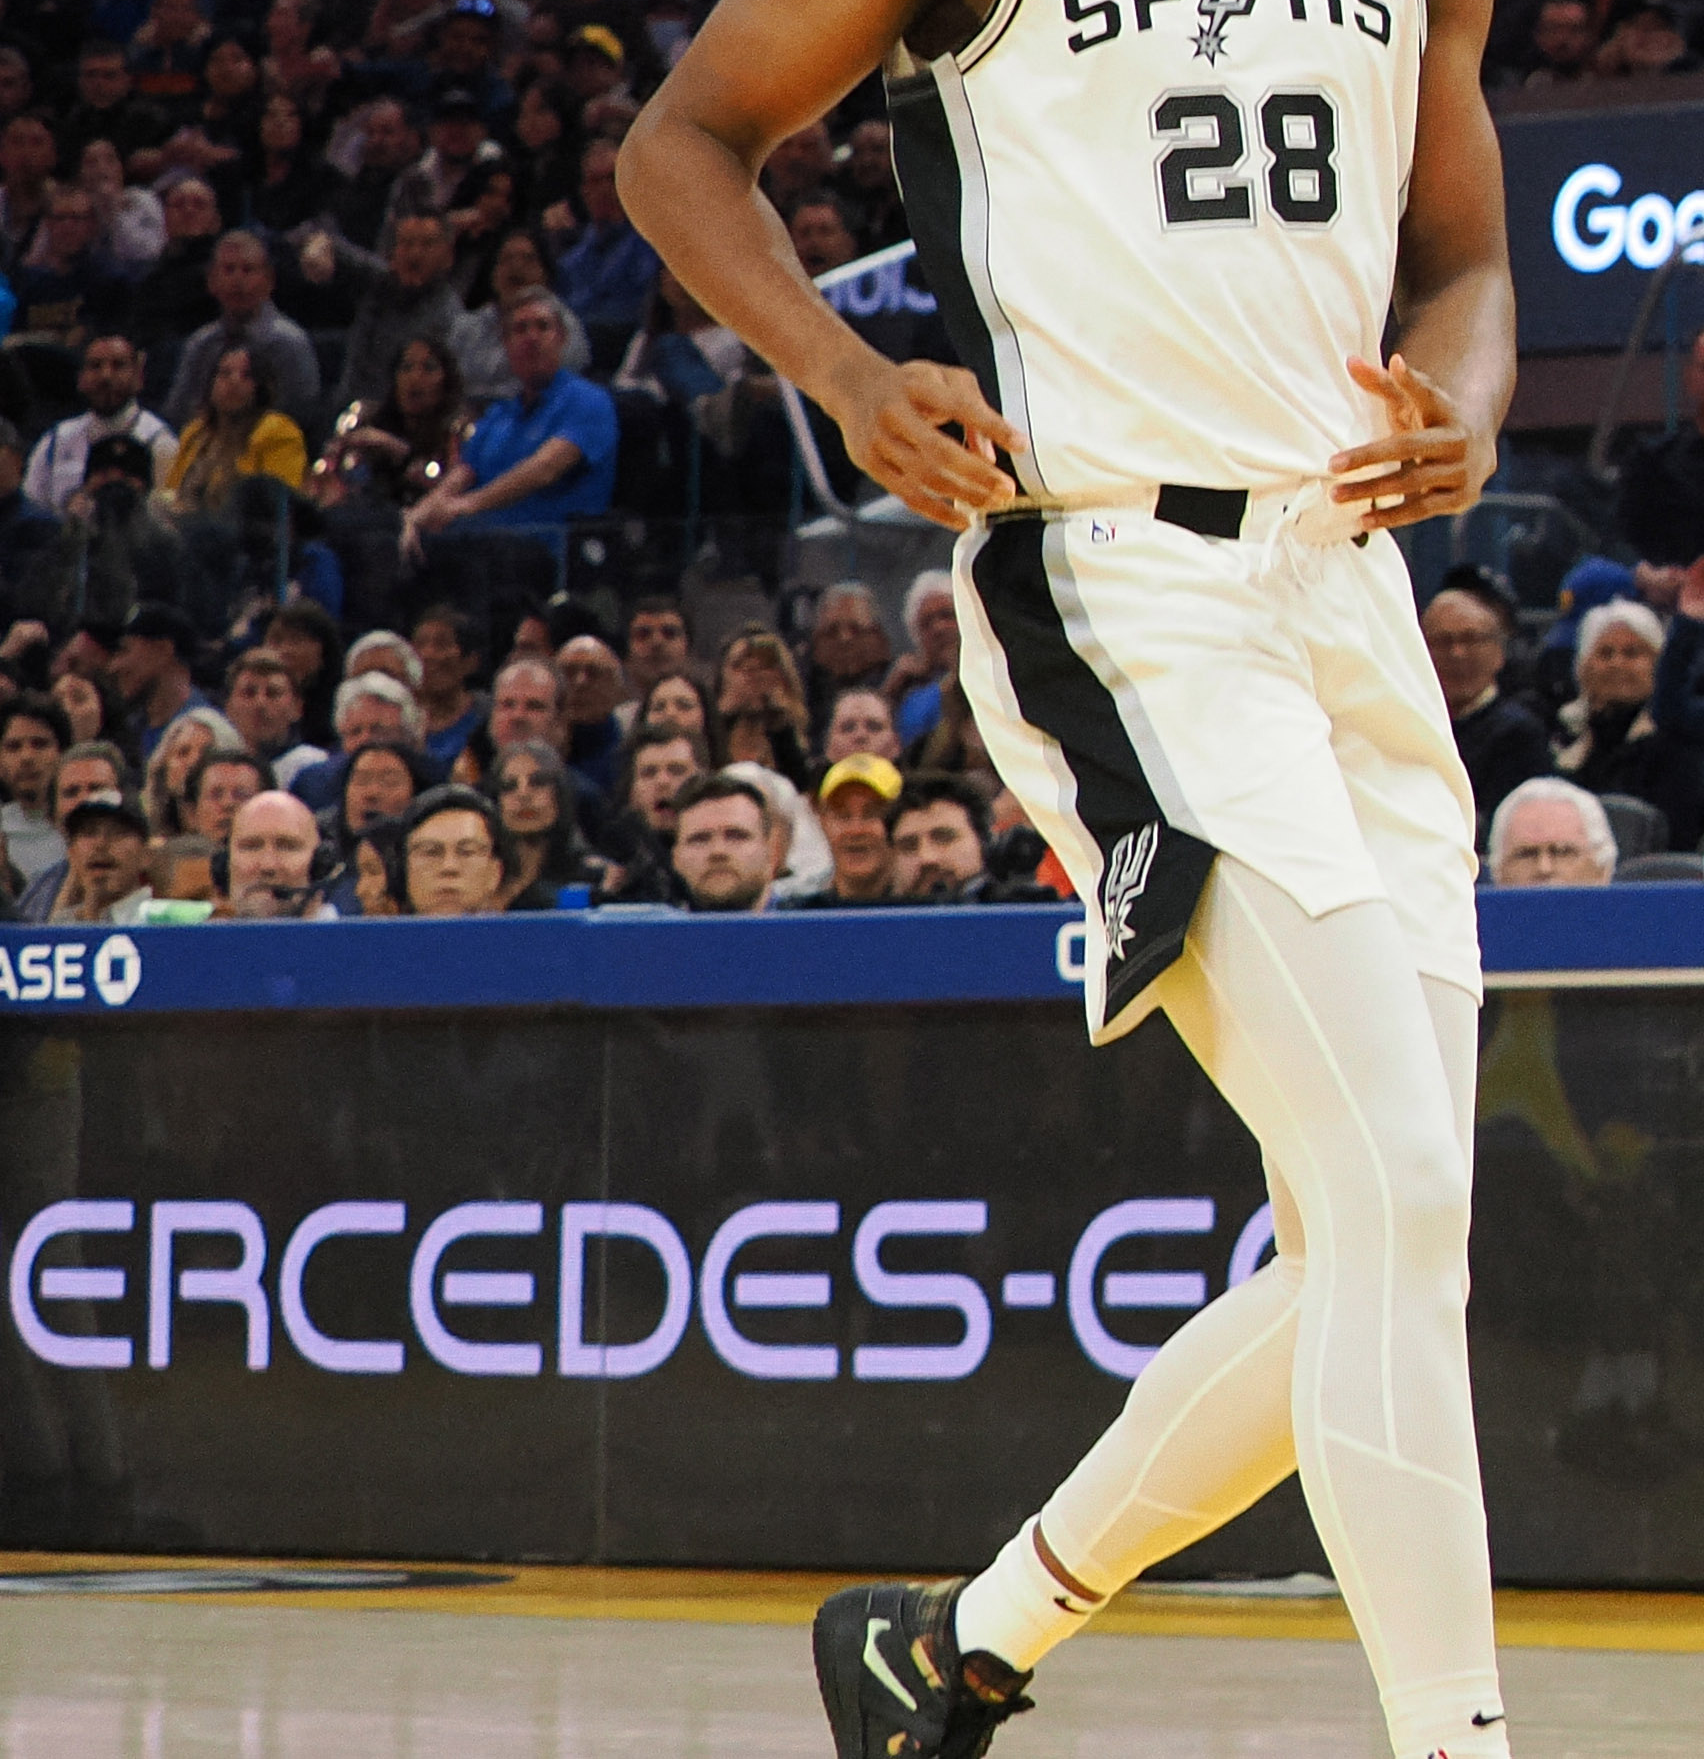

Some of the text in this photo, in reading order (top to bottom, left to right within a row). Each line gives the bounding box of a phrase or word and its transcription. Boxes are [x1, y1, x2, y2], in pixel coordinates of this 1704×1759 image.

[1147, 84, 1343, 232] 28
[0, 942, 88, 1001] ASE
[8, 1197, 1277, 1381] ERCEDES-E
